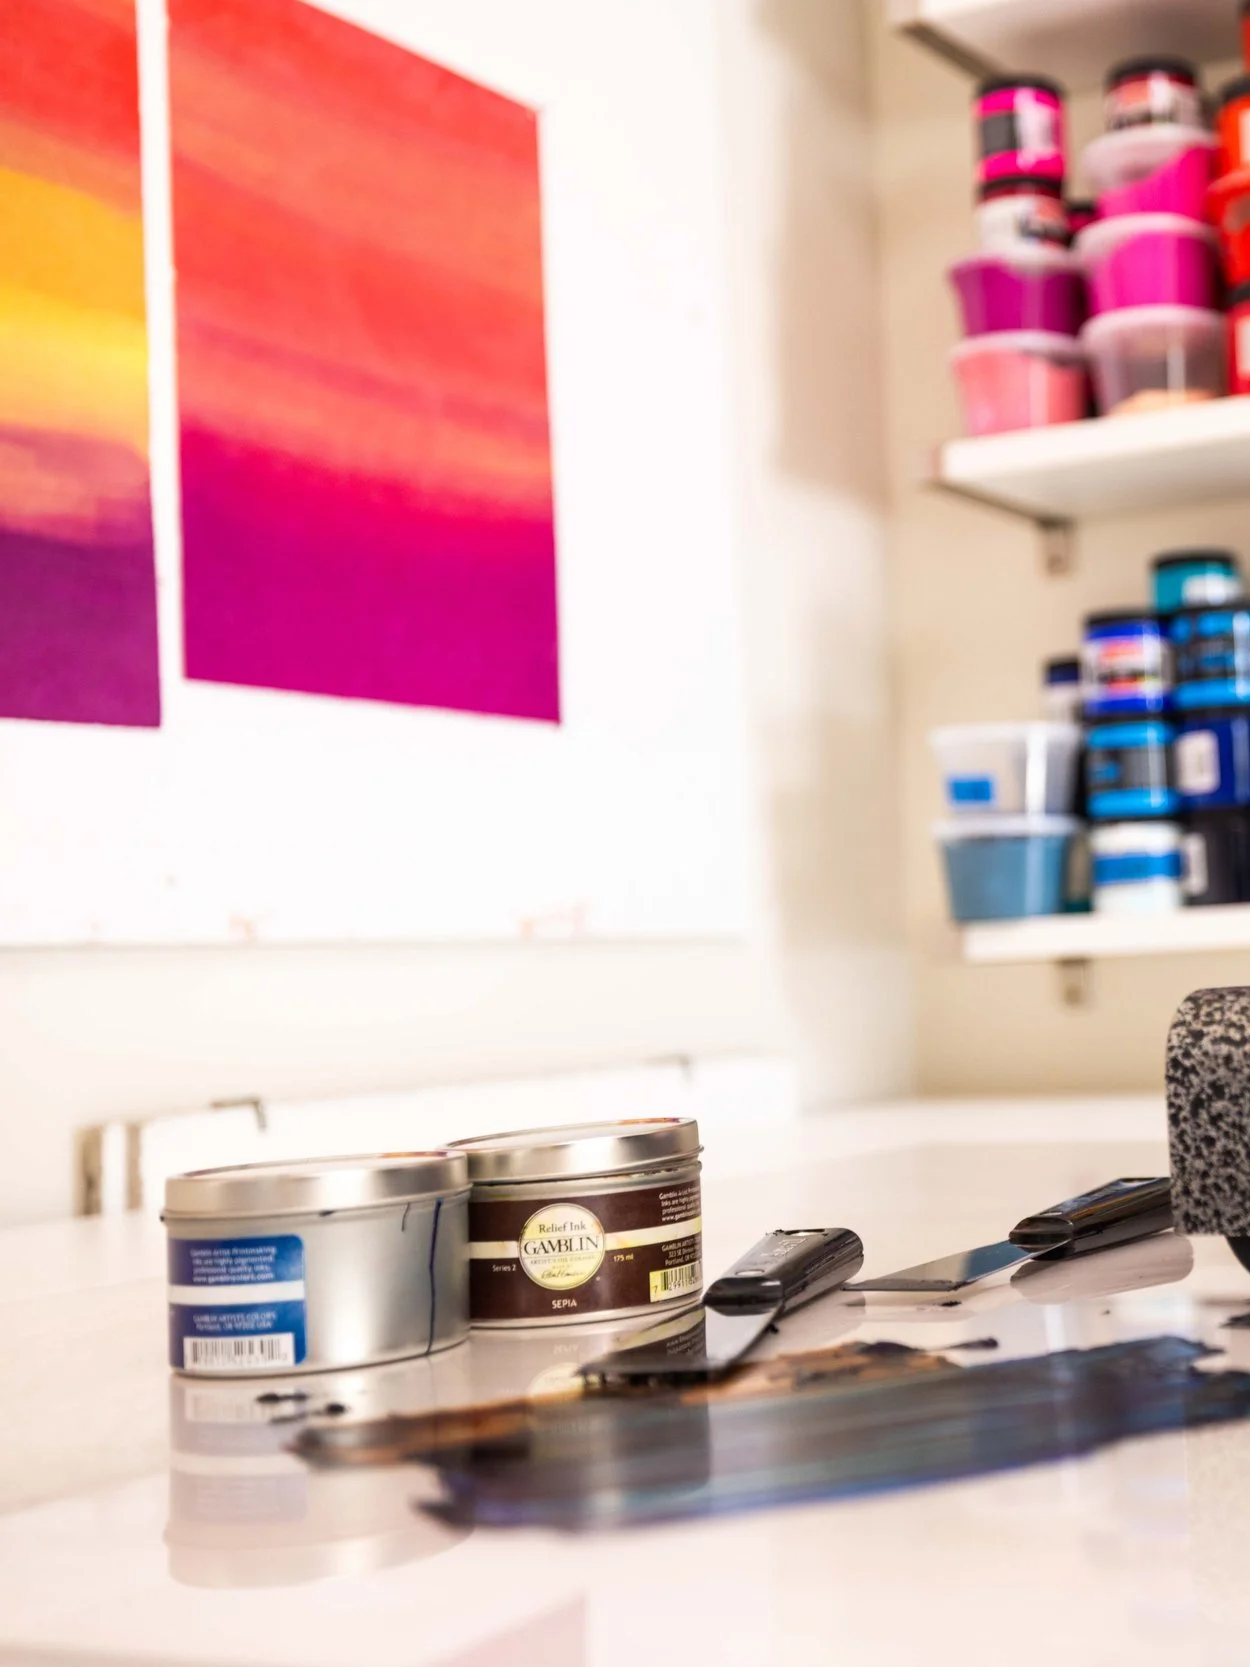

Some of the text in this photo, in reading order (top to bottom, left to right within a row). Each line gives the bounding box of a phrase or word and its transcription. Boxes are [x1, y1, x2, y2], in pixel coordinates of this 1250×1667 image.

[539, 1219, 586, 1233] Relief Ink
[524, 1236, 598, 1255] GAMBLIN
[613, 1252, 633, 1262] 175 ml
[492, 1264, 510, 1272] Series
[551, 1299, 577, 1309] SEPIA
